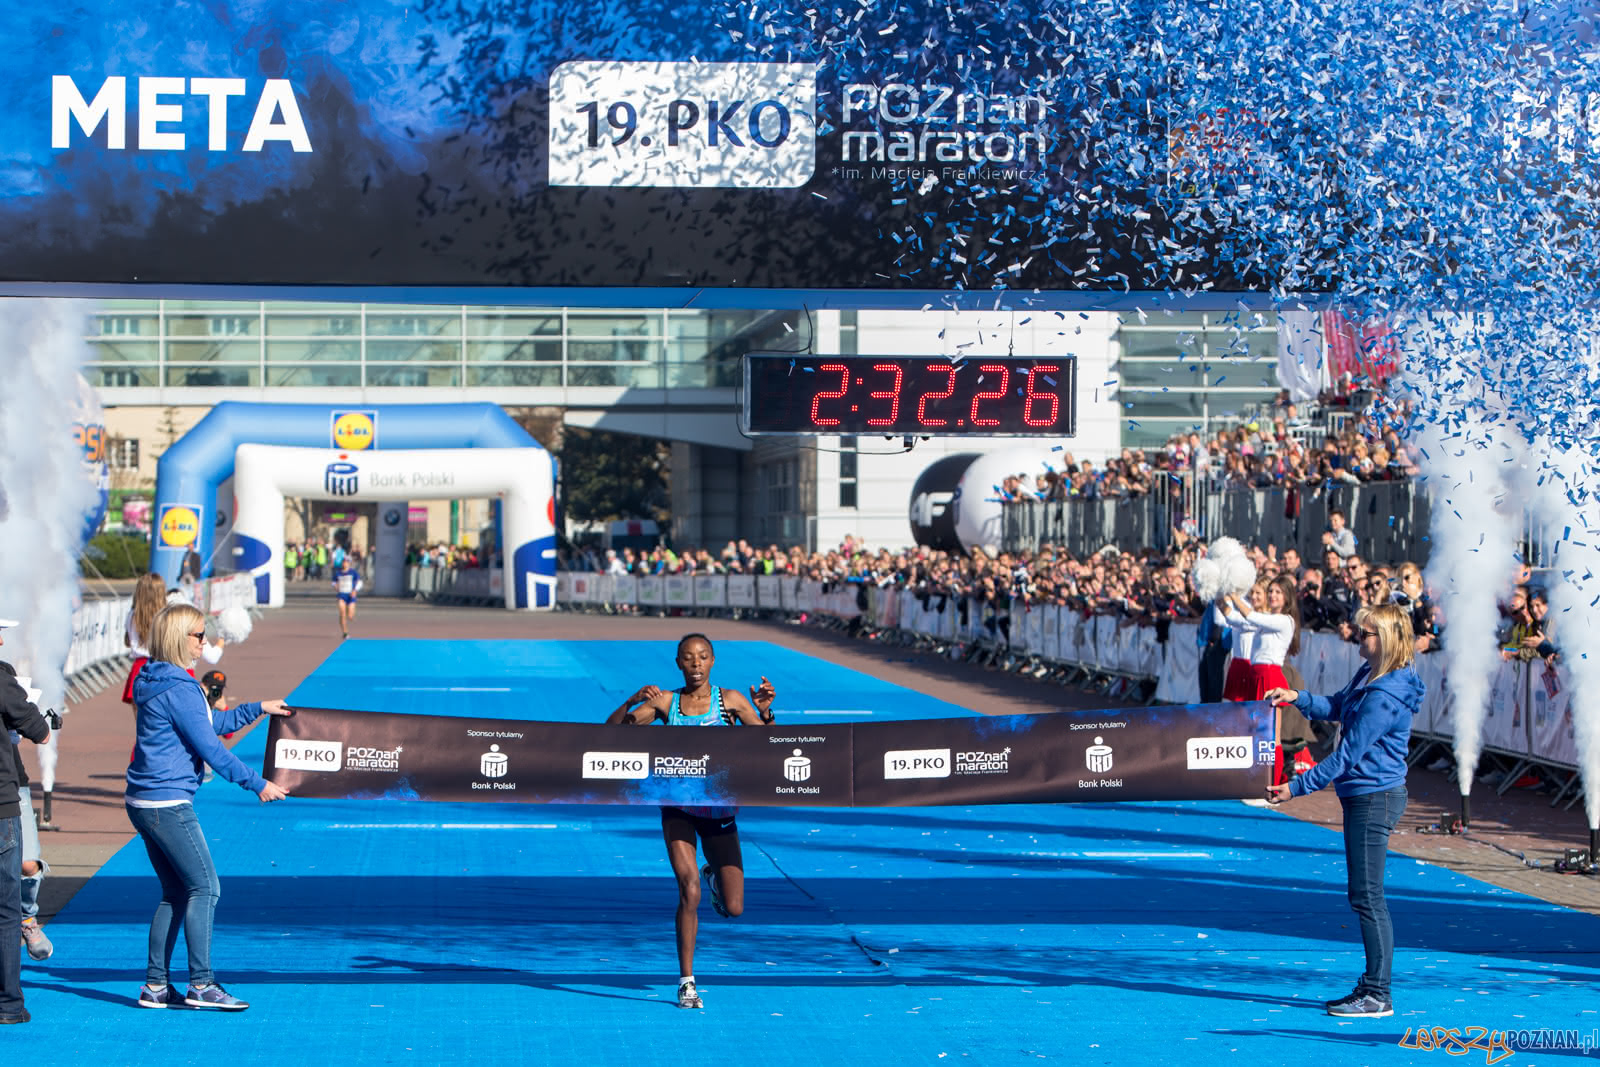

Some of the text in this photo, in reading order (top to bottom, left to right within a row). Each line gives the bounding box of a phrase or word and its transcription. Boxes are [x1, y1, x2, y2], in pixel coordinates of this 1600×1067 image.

[51, 75, 314, 153] META
[575, 99, 792, 148] 19. PKO
[841, 131, 1047, 162] maraton
[942, 166, 1047, 181] Frankiewicza
[811, 364, 1060, 426] 2:32.26
[369, 472, 455, 487] Bank Polski
[1069, 721, 1127, 731] Sponsor tytularny
[466, 729, 524, 740] Sponsor tytularny
[769, 736, 797, 744] Sponsor
[282, 748, 336, 762] 19. PKO
[1193, 745, 1248, 760] 19. PKO
[346, 757, 399, 769] maraton
[589, 760, 643, 772] 19. PKO
[891, 757, 945, 771] 19. PKO
[956, 761, 1009, 772] maraton
[654, 766, 707, 775] maraton
[471, 781, 516, 790] Bank Polski
[1078, 778, 1123, 788] Bank Polski
[775, 786, 820, 794] Bank Polski
